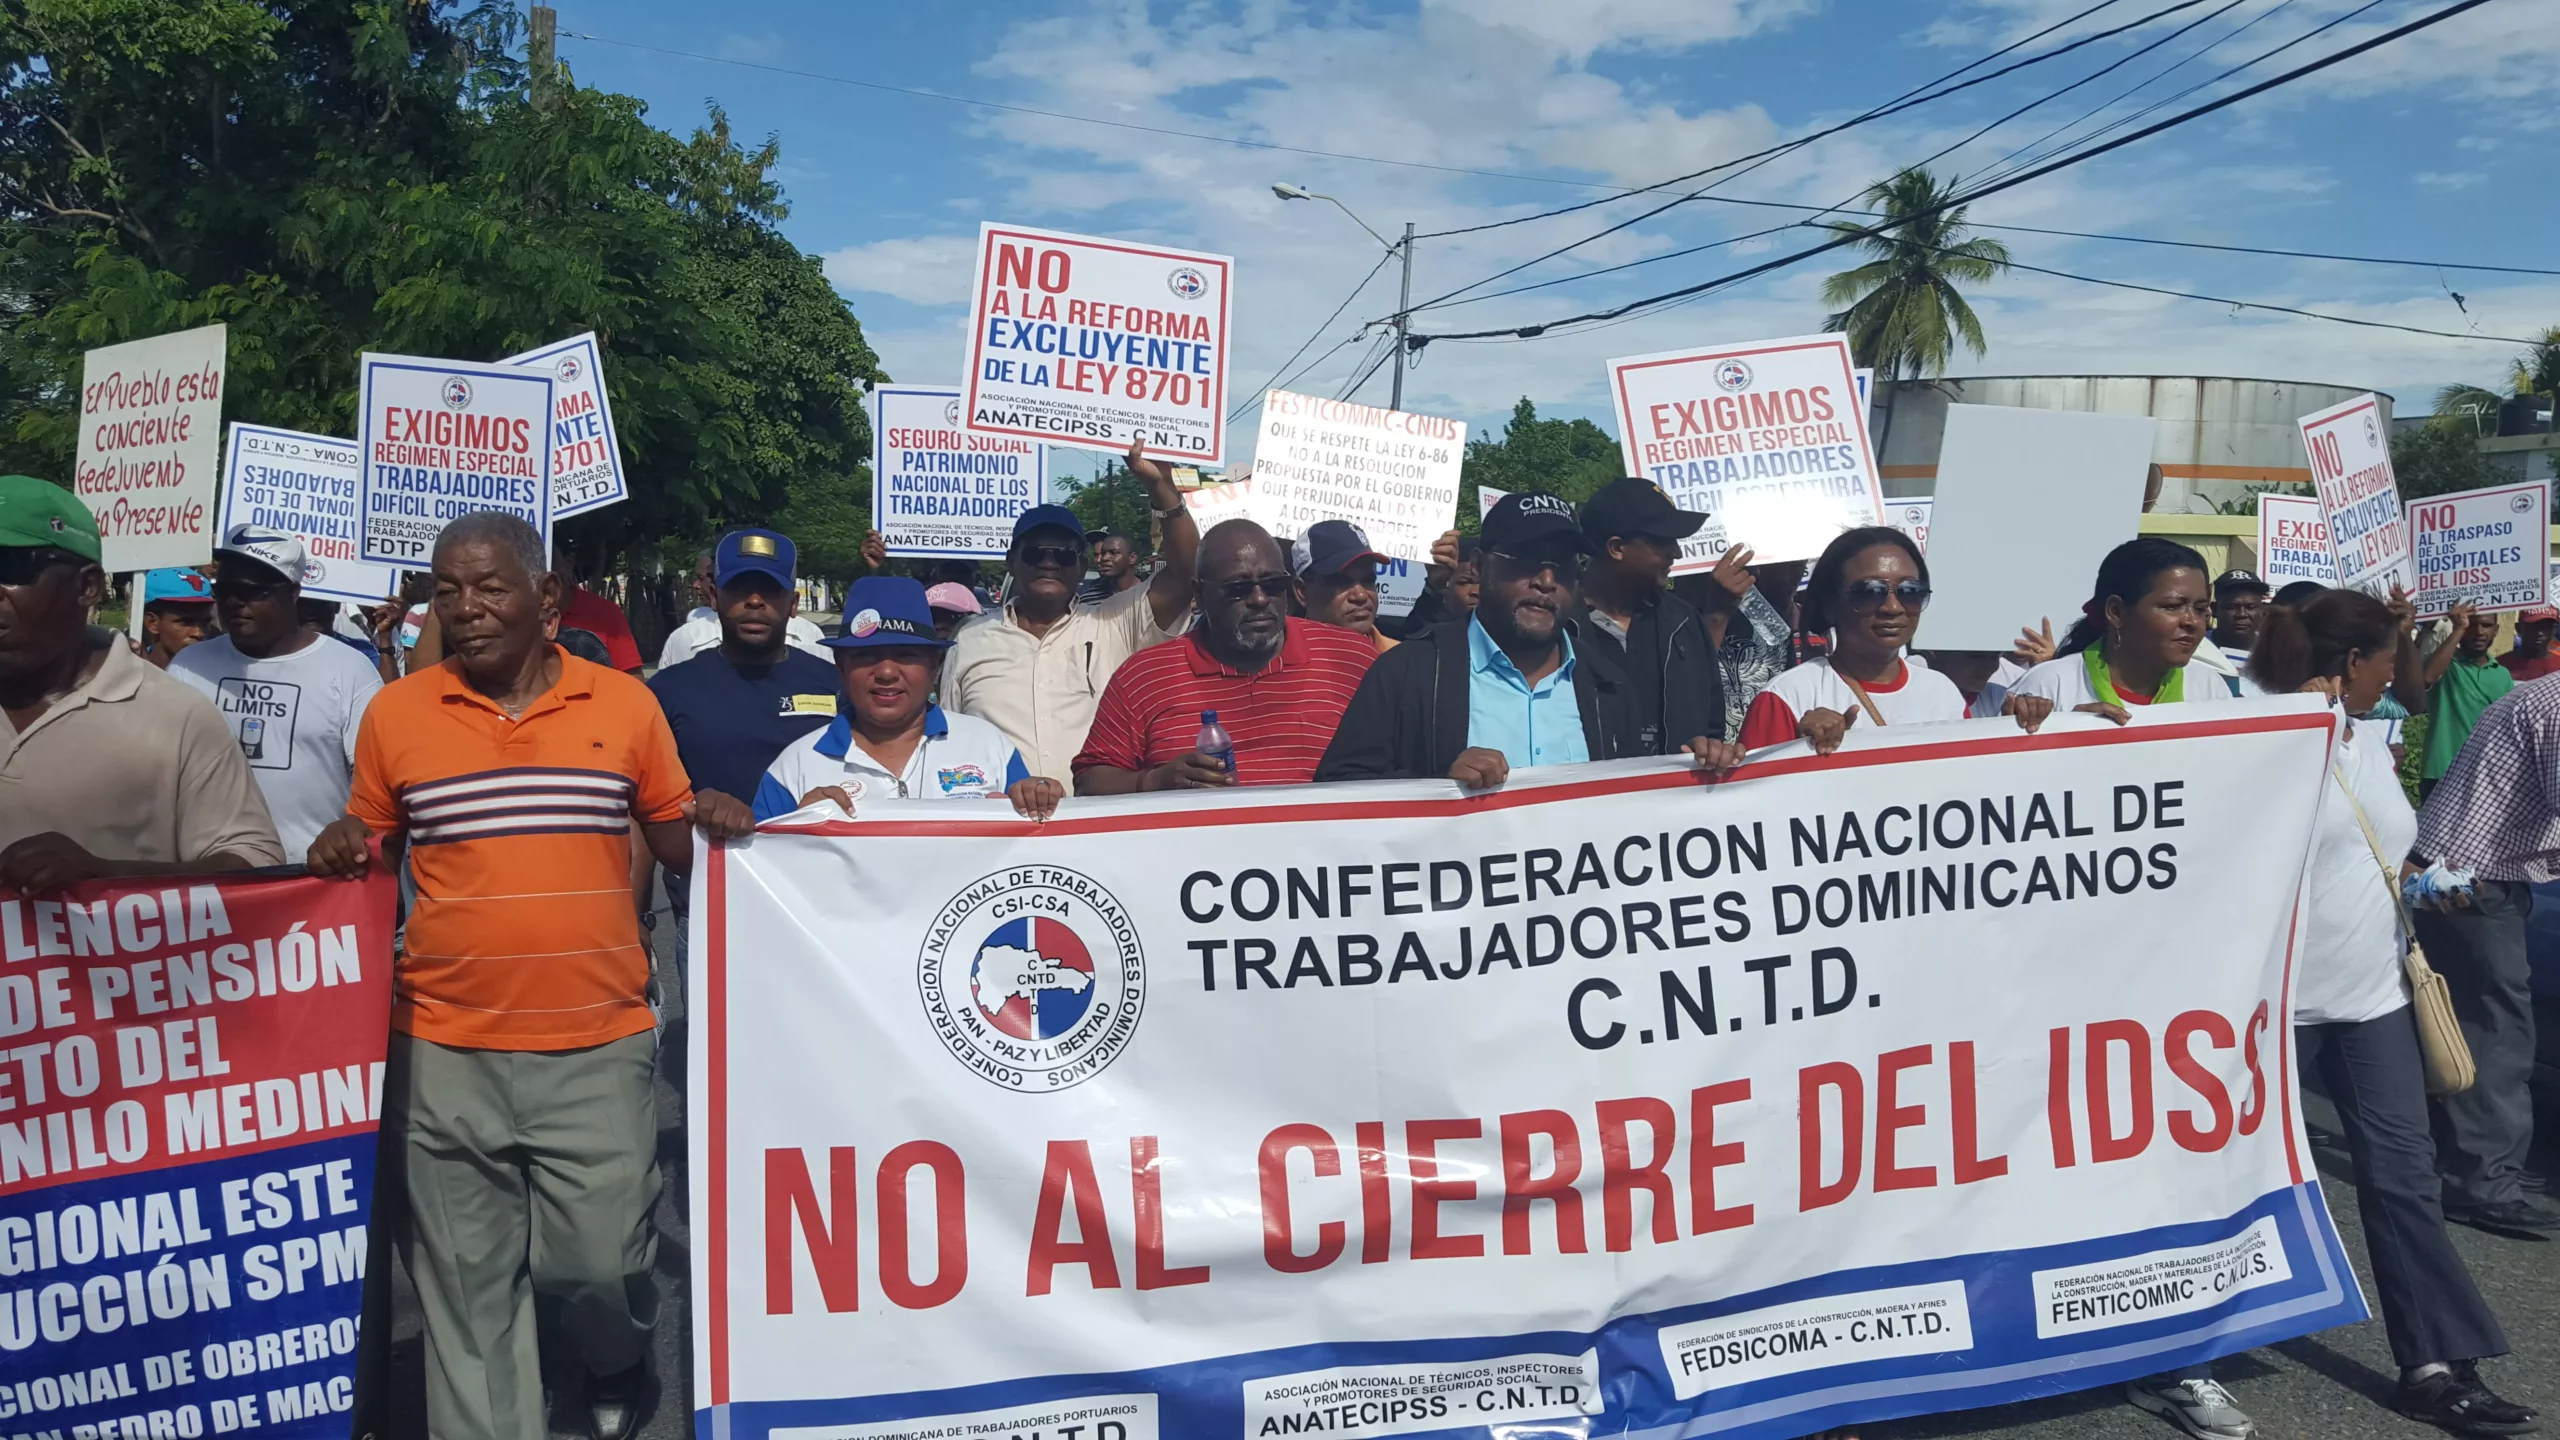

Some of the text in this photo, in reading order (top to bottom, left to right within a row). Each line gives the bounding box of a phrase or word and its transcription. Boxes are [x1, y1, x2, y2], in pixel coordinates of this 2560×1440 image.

[997, 244, 1071, 293] NO
[991, 290, 1210, 342] A LA REFORMA
[988, 318, 1211, 374] EXCLUYENTE
[105, 369, 170, 411] Pueblo
[176, 361, 219, 403] esta
[984, 358, 1210, 408] DE LA LEY 8701
[385, 407, 529, 454] EXIGIMOS
[975, 409, 1211, 452] ANATECIPSS C.N.T.D.
[981, 392, 1036, 404] ASOCIACIÓN
[1039, 400, 1084, 411] NACIONAL
[1101, 406, 1148, 420] TÉCNICOS,
[1150, 414, 1210, 428] INSPECTORES
[1016, 404, 1078, 418] PROMOTORES
[1095, 415, 1146, 427] SEGURIDAD
[1148, 422, 1180, 432] SOCIAL
[1650, 386, 1834, 439] EXIGIMOS
[375, 440, 450, 469] RÉGIMEN
[456, 450, 537, 477] ESPECIAL
[889, 428, 961, 450] SEGURO
[1271, 422, 1448, 463] QUE SE RESPETE LA LEY 6-86
[1646, 422, 1853, 464] RÉGIMEN ESPECIAL
[2312, 431, 2343, 482] NO
[376, 465, 535, 504] TRABAJADORES
[903, 452, 1018, 475] PATRIMONIO
[1257, 459, 1452, 503] PROPUESTA POR EL GOBIERNO
[1345, 456, 1425, 480] RESOLUCION
[1651, 445, 1855, 491] TRABAJADORES
[2349, 462, 2389, 503] REFORMA
[372, 489, 429, 517] DIFÍCIL
[890, 495, 1030, 518] TRABAJADORES
[893, 475, 1028, 496] NACIONAL DE LOS
[1294, 486, 1363, 510] PERJUDICA
[1519, 495, 1571, 515] CNTD
[368, 517, 441, 532] FEDERACION
[2332, 489, 2397, 545] EXCLUYENTE
[2419, 522, 2512, 546] AL TRASPASO
[2420, 504, 2455, 532] NO
[246, 545, 280, 562] NIKE
[366, 537, 424, 557] FDTP
[884, 535, 972, 547] ANATECIPSS
[2360, 521, 2405, 568] LEY 8701
[2419, 543, 2456, 558] DE LOS
[2419, 546, 2521, 574] HOSPITALES
[2270, 562, 2312, 577] DIFÍCIL
[2419, 574, 2448, 591] DEL
[2454, 568, 2490, 586] IDSS
[223, 698, 286, 717] LIMITS
[242, 684, 273, 700] NO
[1180, 780, 2184, 924] CONFEDERACION NACIONAL DE
[1009, 870, 1033, 886] DE
[1, 883, 232, 962] LENCIA
[928, 879, 1005, 953] NACIONAL
[992, 895, 1070, 918] CSI-CSA
[1040, 870, 1140, 982] TRABAJADORES
[1187, 843, 2178, 992] TRABAJADORES DOMINICANOS
[88, 921, 362, 1020] PENSIÓN
[1017, 973, 1056, 985] CNTD
[1567, 946, 1881, 1051] C.N.T.D.
[923, 958, 1023, 1086] CONFEDERACION
[958, 1002, 1110, 1062] PAN PAZ LIBERTAD
[1047, 988, 1140, 1086] DOMINICANOS
[0, 1016, 230, 1112] ETO DEL
[0, 1099, 148, 1186] NILO
[764, 999, 2269, 1315] NO AL CIERRE DEL IDSS
[0, 1158, 358, 1276] GIONAL ESTE
[2052, 1264, 2212, 1299] LA CONSTRUCCIÓN, MADERA MATERIALES
[2053, 1252, 2273, 1324] FENTICOMMC C.N.U.S.
[2054, 1254, 2215, 1288] FEDERACIÓN NACIONAL DE TRABAJADORES
[0, 1252, 232, 1350] UCCIÓN
[1677, 1299, 1947, 1349] FEDERACIÓN DE SINDICATOS DE LA CONSTRUCCIÓN, MADERA AFINES
[1680, 1311, 1950, 1376] FEDSICOMA C.N.T.D.
[0, 1363, 138, 1419] CIONAL
[144, 1350, 195, 1392] DE
[1265, 1364, 1583, 1401] ASOCIACIÓN NACIONAL DE TÉCNICOS, INSPECTORES
[1314, 1374, 1541, 1406] PROMOTORES DE SEGURIDAD SOCIAL
[211, 1394, 260, 1433] DE
[267, 1376, 353, 1424] MAC
[947, 1405, 1138, 1437] DE TRABAJADORES PORTUARIOS
[1260, 1385, 1587, 1437] ANATECIPSS C.N.T.D.
